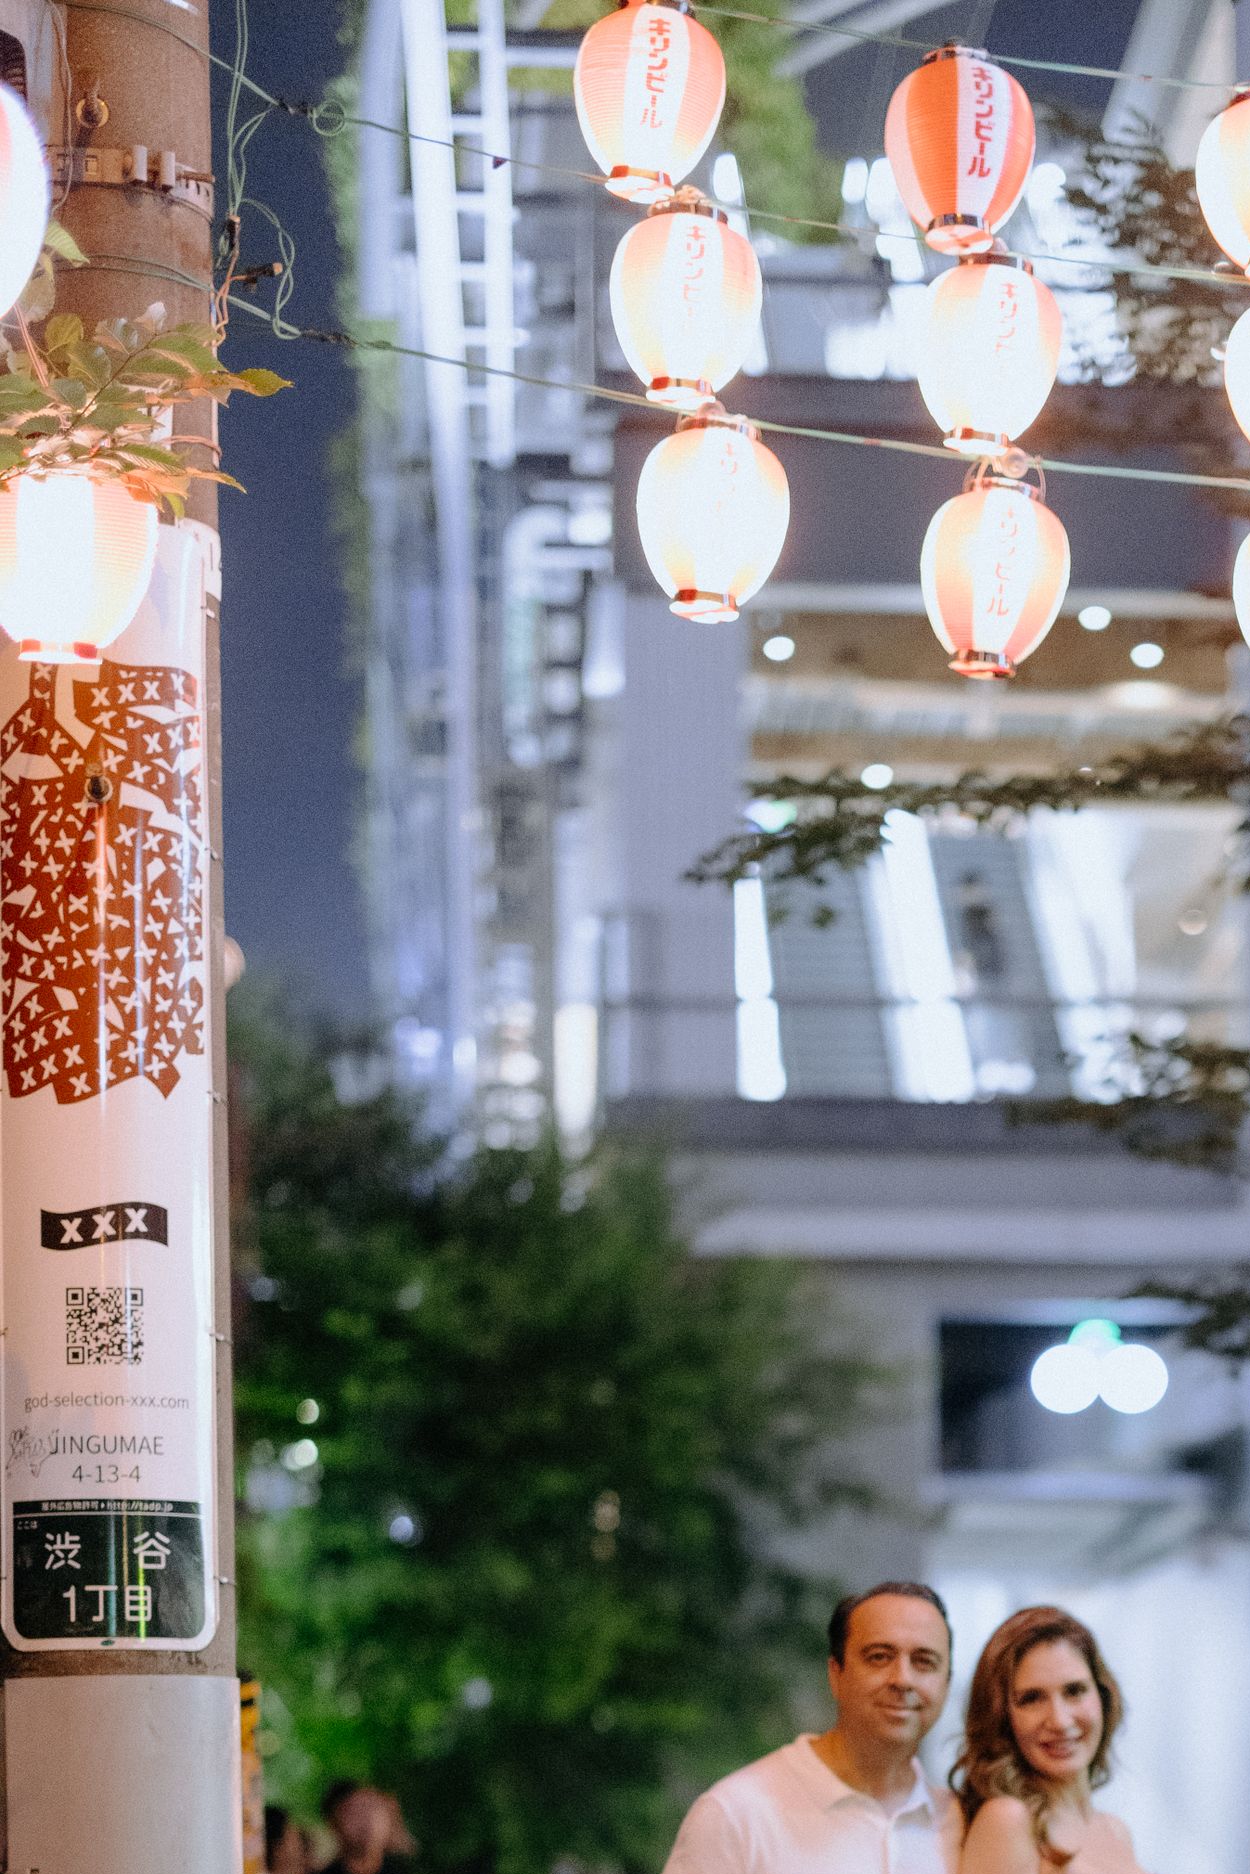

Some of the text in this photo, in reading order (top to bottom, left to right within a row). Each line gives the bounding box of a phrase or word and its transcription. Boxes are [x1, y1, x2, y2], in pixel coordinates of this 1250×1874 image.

[640, 16, 672, 130] キリンビール
[966, 65, 995, 179] キリンビール
[24, 1391, 190, 1413] god-selection-xxx.com
[50, 1435, 165, 1455] JINGUMAE
[71, 1464, 141, 1483] 4-13-4
[45, 1531, 171, 1570] 渋谷
[63, 1585, 152, 1622] 1丁目
